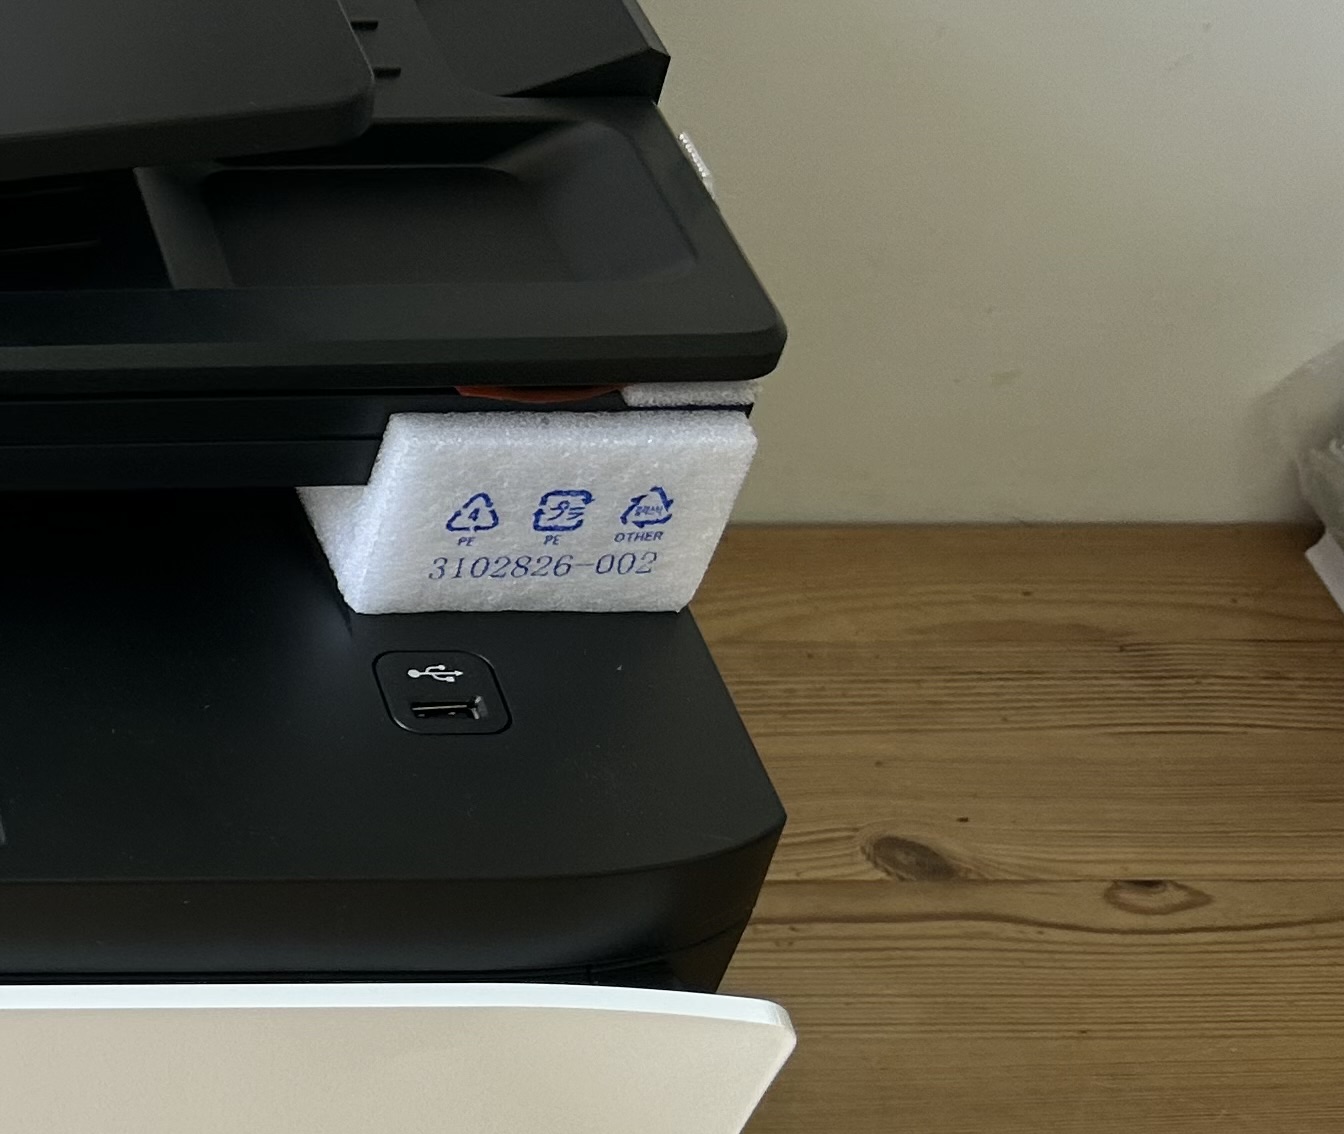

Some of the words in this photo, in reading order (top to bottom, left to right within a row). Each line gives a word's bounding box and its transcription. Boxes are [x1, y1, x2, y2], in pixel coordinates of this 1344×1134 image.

[457, 535, 476, 547] PE
[543, 535, 561, 547] PE
[613, 530, 664, 544] OTHER
[428, 551, 658, 581] 3102826-002
